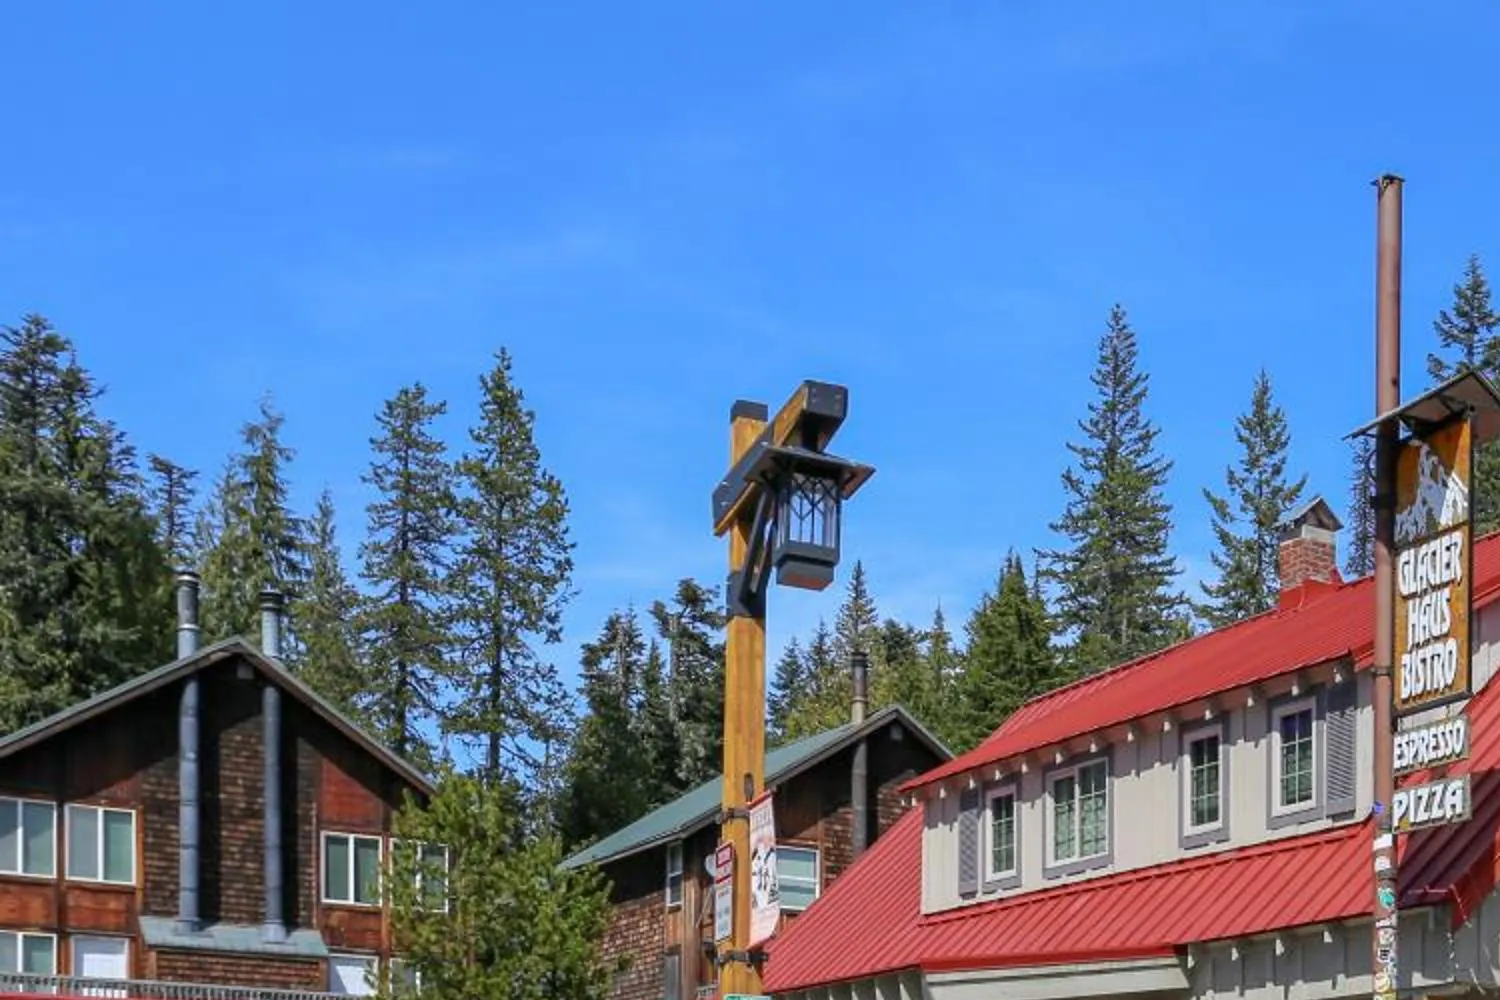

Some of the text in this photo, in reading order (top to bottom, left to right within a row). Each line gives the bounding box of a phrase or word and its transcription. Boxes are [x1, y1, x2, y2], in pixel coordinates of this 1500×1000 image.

[1399, 531, 1463, 595] GLACIER
[1408, 587, 1451, 651] HAUS
[1401, 637, 1458, 699] BISTRO
[1393, 719, 1465, 769] ESPRESSO
[1392, 779, 1465, 827] PIZZA
